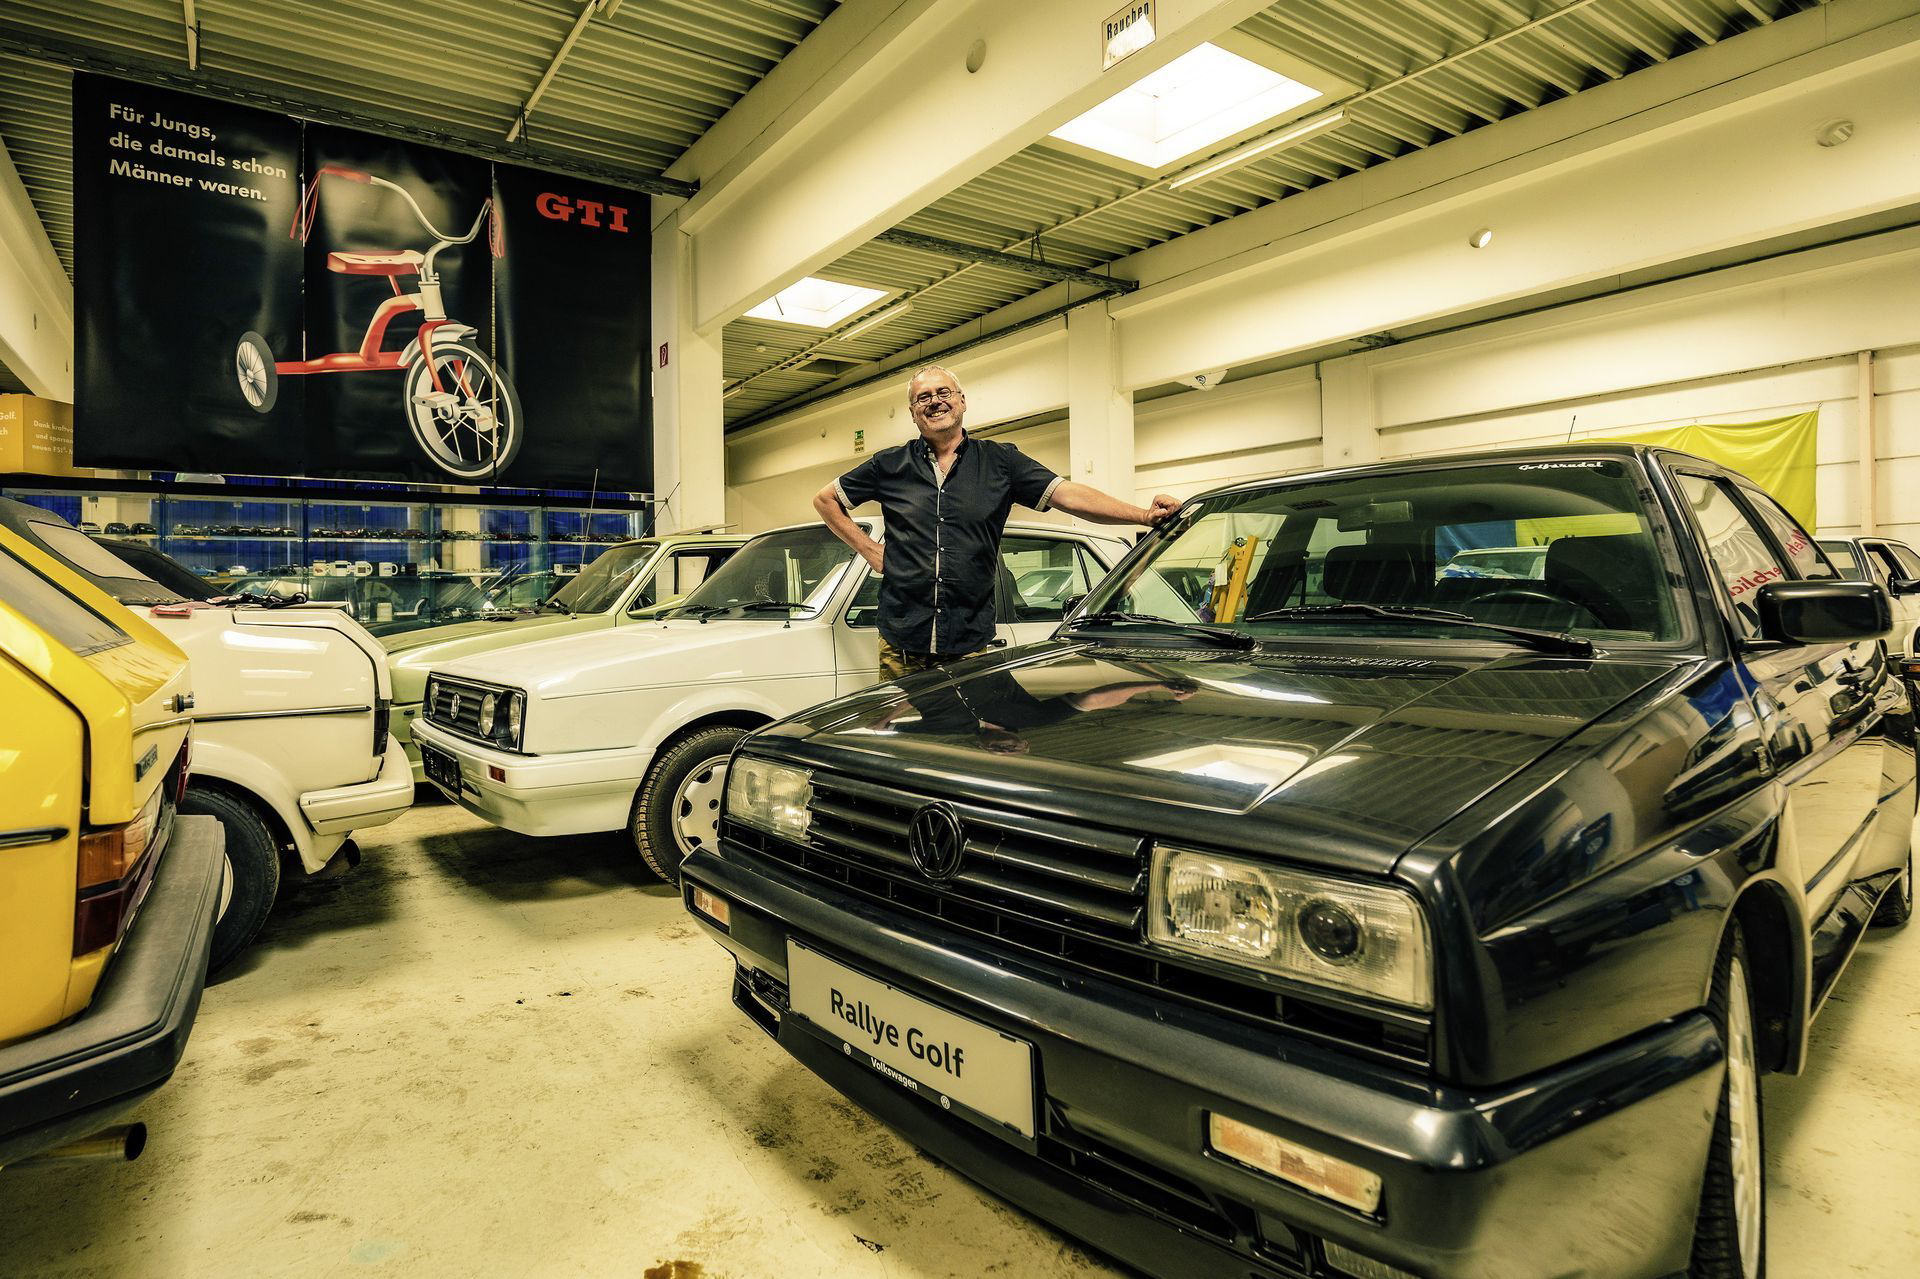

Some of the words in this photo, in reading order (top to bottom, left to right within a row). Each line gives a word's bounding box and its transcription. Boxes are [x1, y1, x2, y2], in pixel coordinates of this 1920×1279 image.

[1107, 3, 1149, 40] Rauchen
[109, 103, 145, 123] Für
[149, 112, 217, 142] Jungs,
[109, 131, 143, 152] die
[149, 139, 226, 167] damals
[232, 157, 287, 179] schon
[109, 158, 193, 187] Männer
[198, 179, 267, 201] waren.
[535, 191, 629, 233] GTI
[33, 420, 50, 429] Dank
[830, 987, 900, 1047] Rallye
[906, 1026, 964, 1079] Golf
[870, 1056, 919, 1092] Volkswagen
